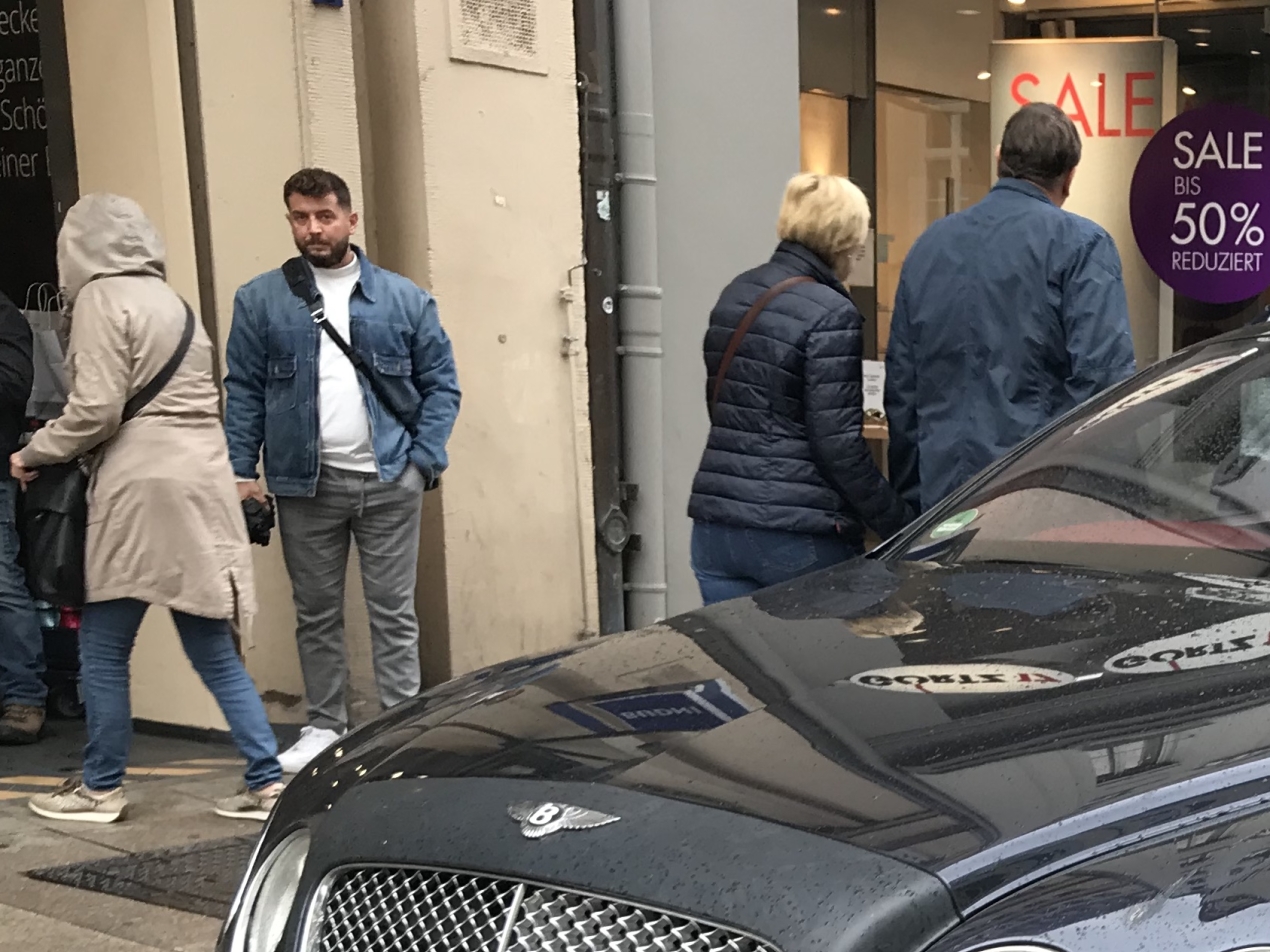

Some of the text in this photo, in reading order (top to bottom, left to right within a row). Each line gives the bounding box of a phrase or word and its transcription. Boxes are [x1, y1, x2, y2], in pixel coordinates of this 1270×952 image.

[1010, 72, 1155, 137] SALE
[1173, 131, 1263, 169] SALE
[1174, 176, 1201, 196] BIS
[1170, 202, 1264, 246] 50%
[1172, 251, 1263, 271] REDUZIERT
